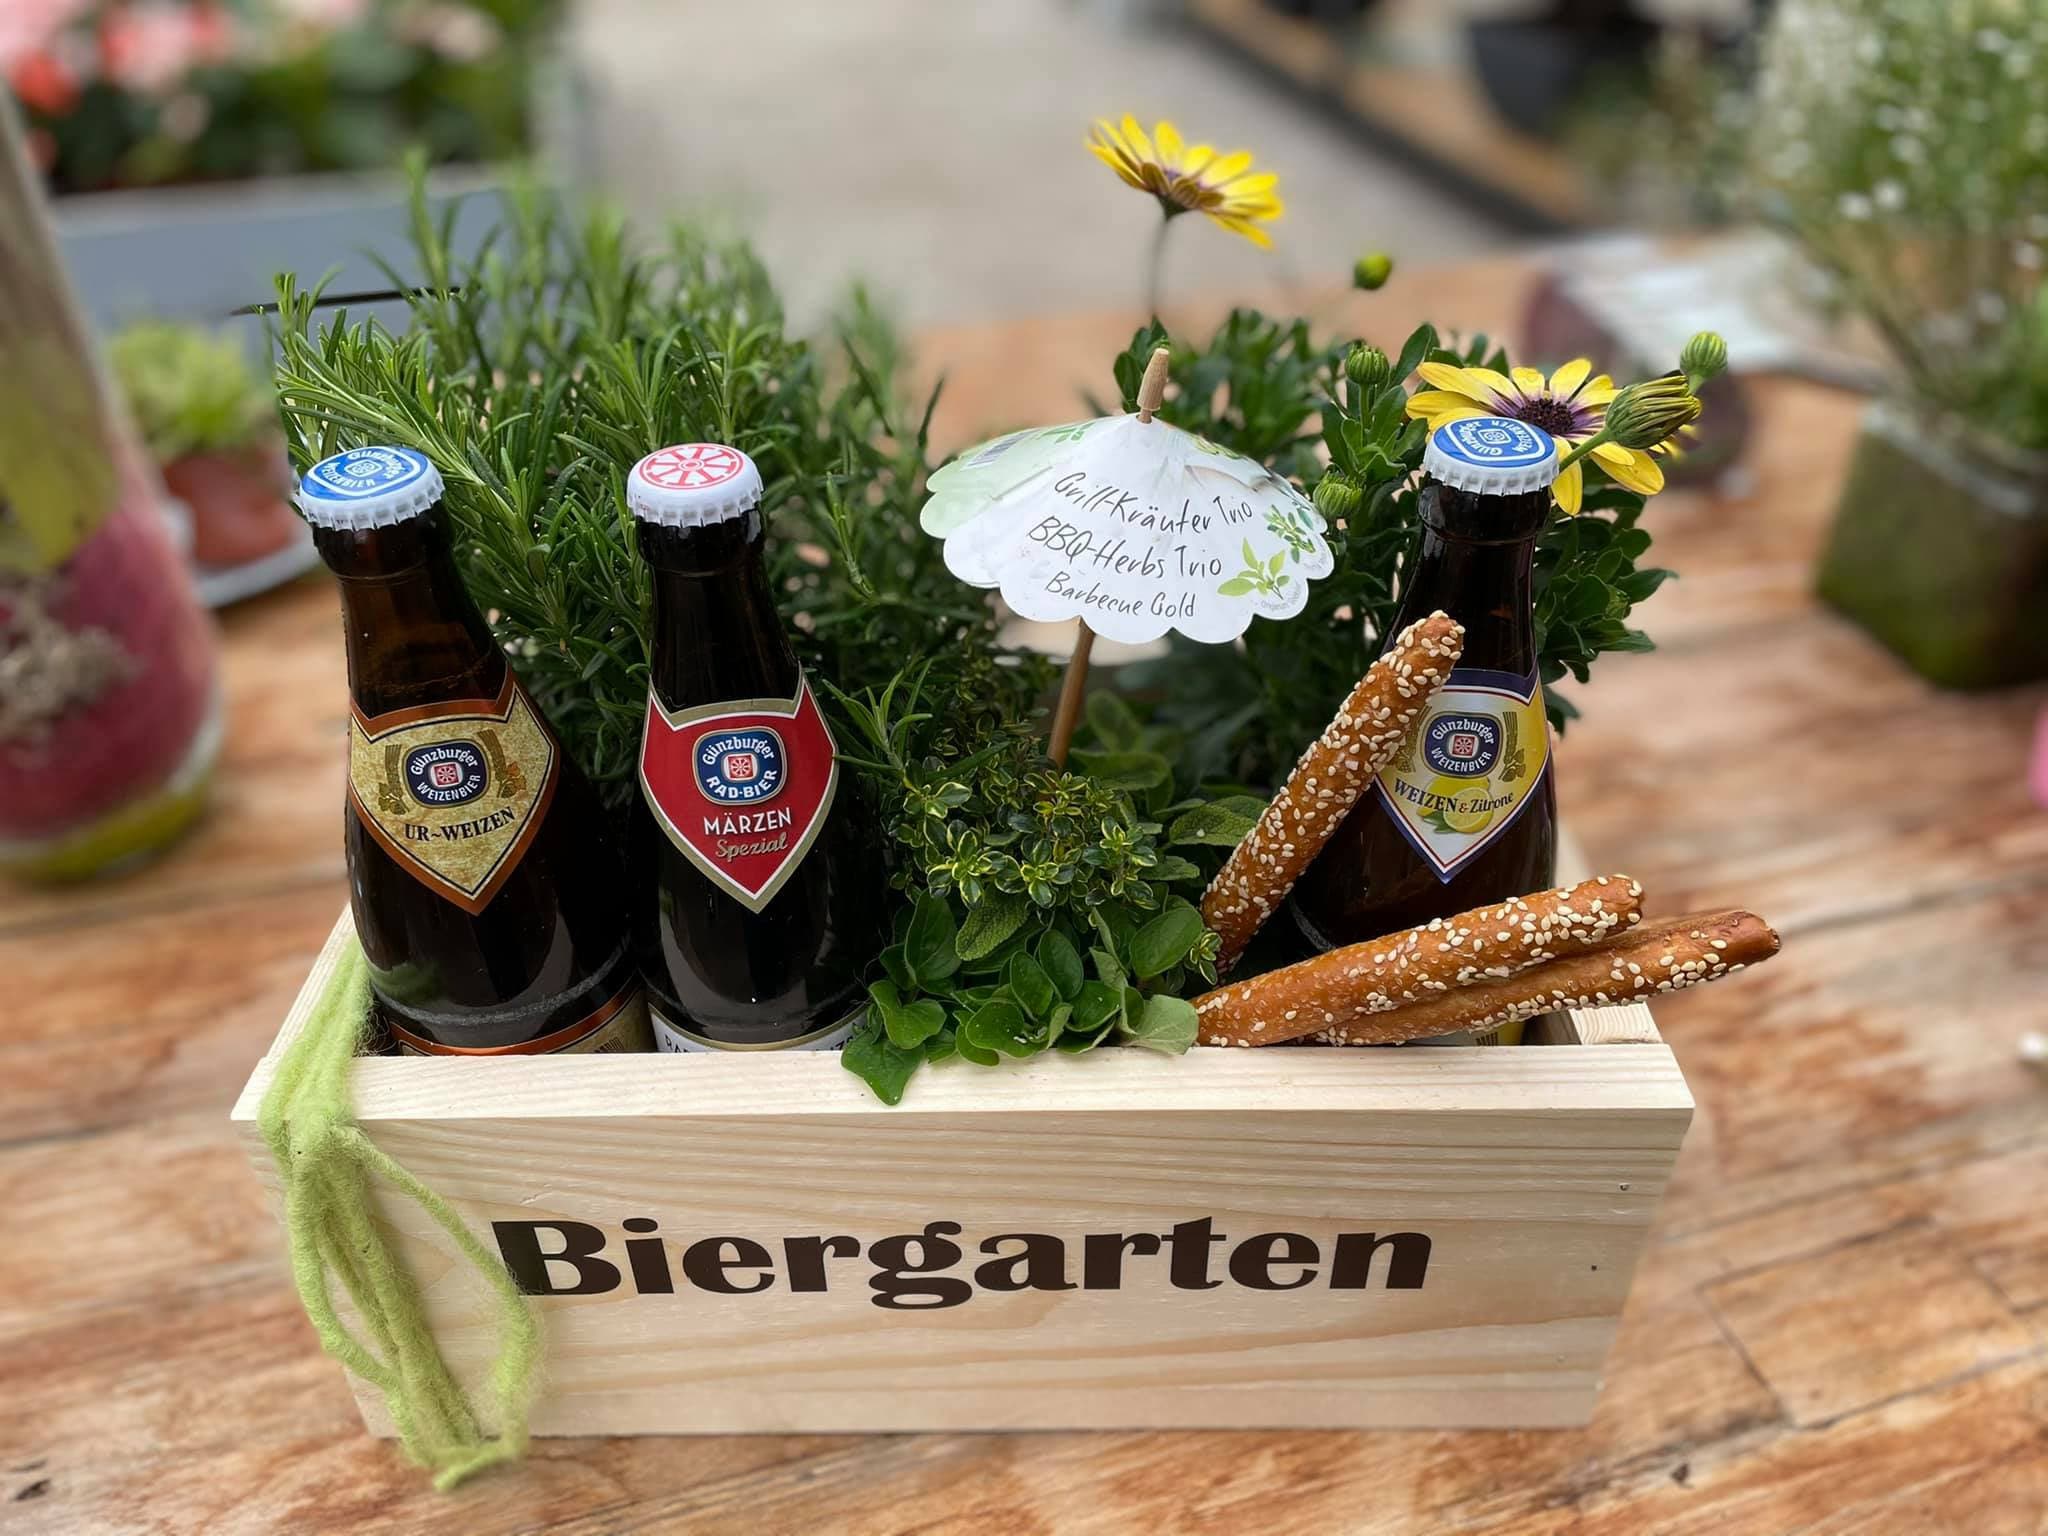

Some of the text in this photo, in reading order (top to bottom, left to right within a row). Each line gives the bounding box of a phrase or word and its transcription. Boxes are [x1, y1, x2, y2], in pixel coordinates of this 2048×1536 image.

[1054, 472, 1253, 534] Grill-Kräuter Trio
[1026, 515, 1222, 579] BBQ-Herbs Trio
[1043, 571, 1196, 618] Barbecue Gold
[1431, 719, 1495, 745] Günzburger
[410, 748, 479, 776] Günzburger
[702, 736, 775, 766] Günzburger
[1431, 747, 1493, 773] WEIZENBIER
[416, 774, 481, 801] WEIZENBIER
[1394, 779, 1514, 814] WEIZEN & Zitrone
[703, 807, 792, 836] MÄRZEN
[714, 832, 789, 862] Spezial
[491, 1216, 1433, 1310] Biergarten
